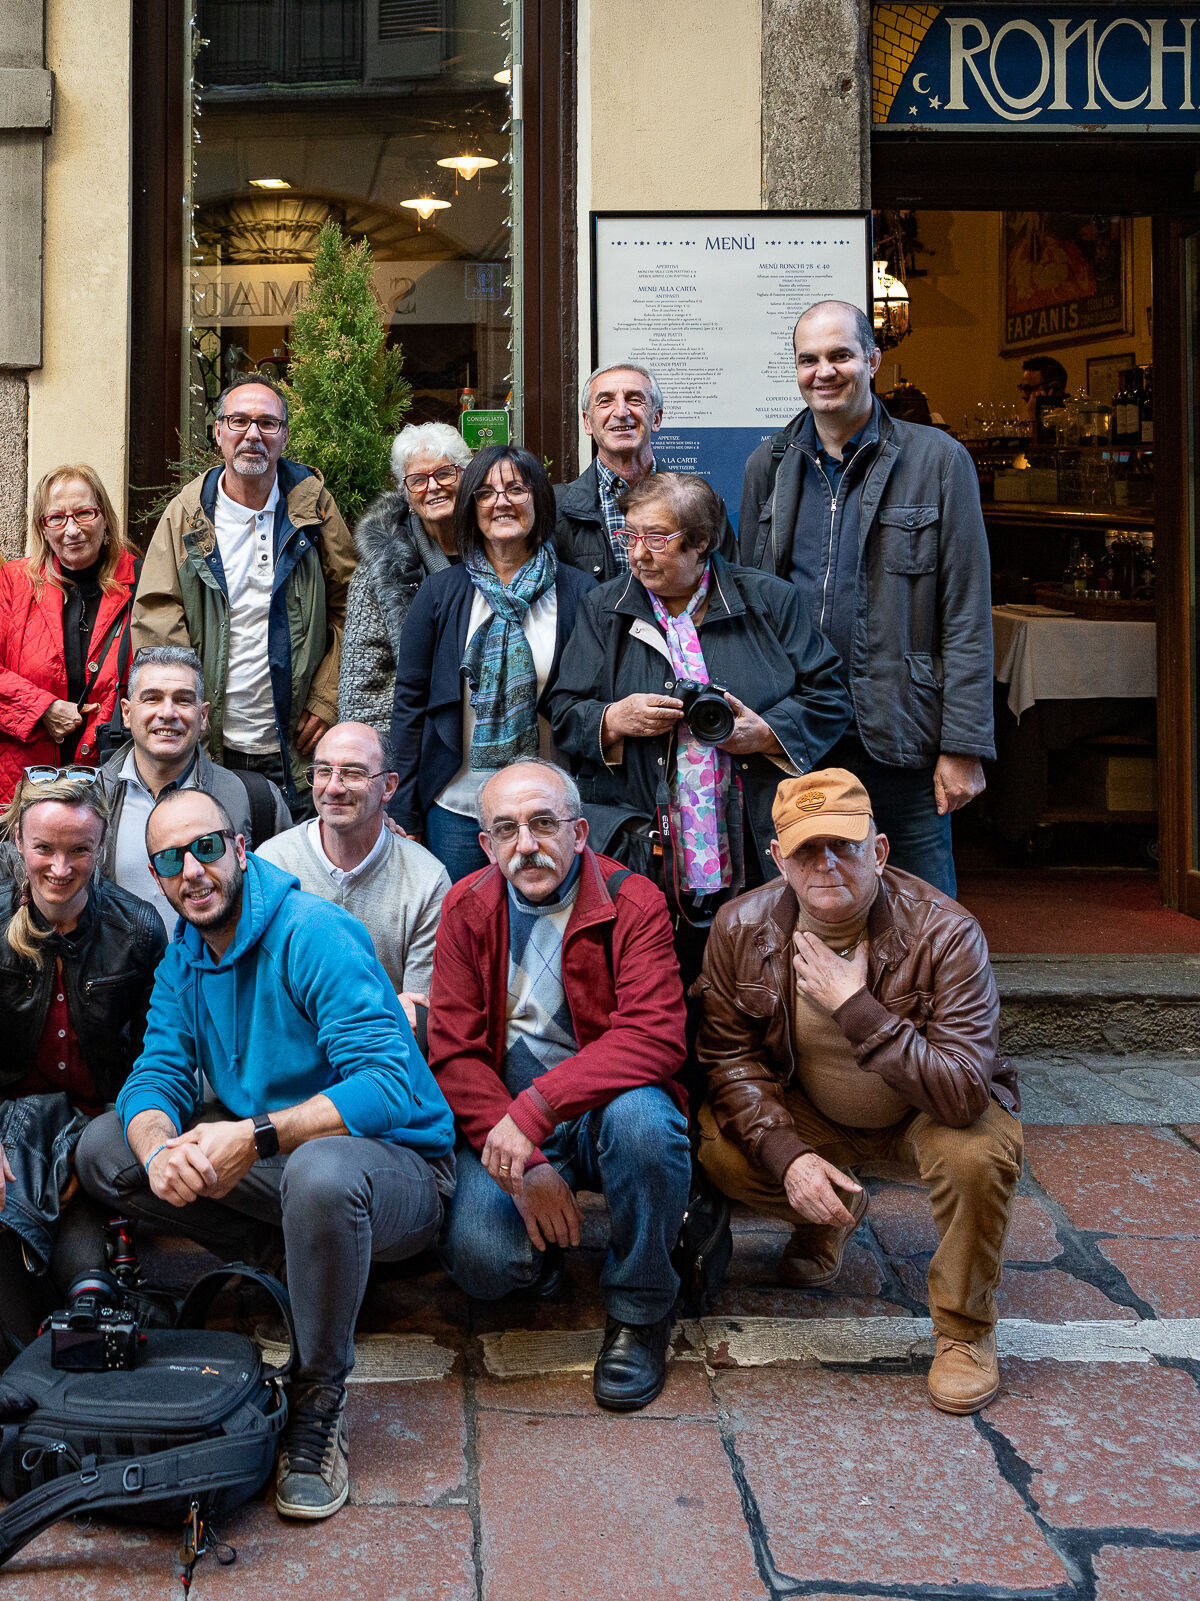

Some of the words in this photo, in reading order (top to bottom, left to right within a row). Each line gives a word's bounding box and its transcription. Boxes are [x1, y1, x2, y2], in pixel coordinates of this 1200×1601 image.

[943, 17, 1200, 121] RONCH
[705, 233, 755, 250] MENÙ
[662, 814, 670, 836] EOS
